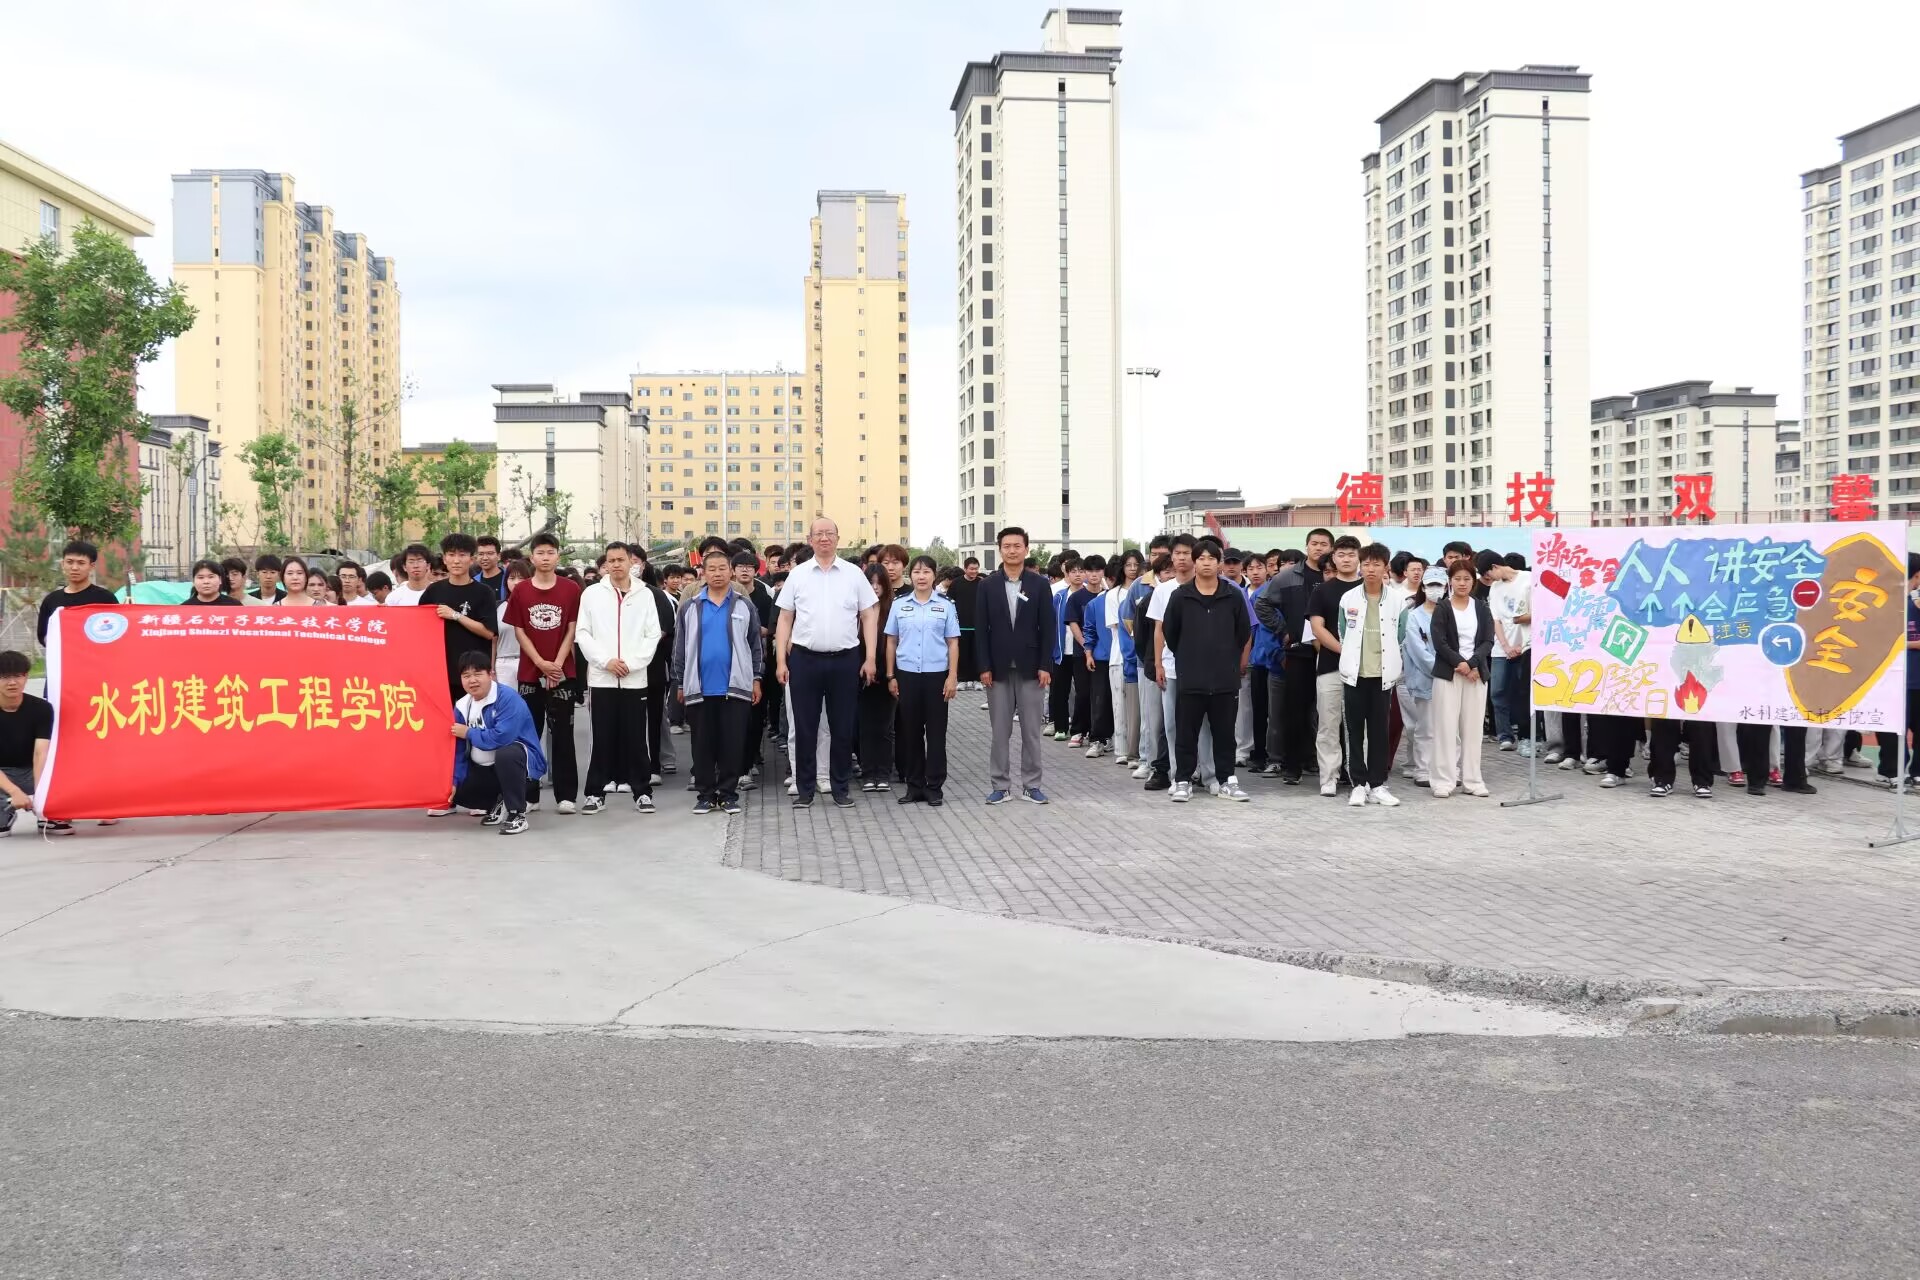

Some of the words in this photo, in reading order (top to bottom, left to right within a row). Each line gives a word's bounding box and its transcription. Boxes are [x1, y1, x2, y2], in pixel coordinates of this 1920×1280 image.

[1335, 471, 1877, 524] 德技双馨
[1536, 532, 1621, 588] 消防安全
[1609, 539, 1825, 592] 人人讲安全
[137, 614, 388, 635] 新疆石河子职业技术学院
[141, 628, 187, 637] Xinjiang
[231, 629, 292, 637] Vocational
[294, 630, 346, 641] Technical
[347, 635, 387, 645] College
[1806, 566, 1889, 674] 安全
[86, 673, 424, 739] 水利建筑工程学院
[1739, 704, 1884, 726] 水利建筑工程学院宣
